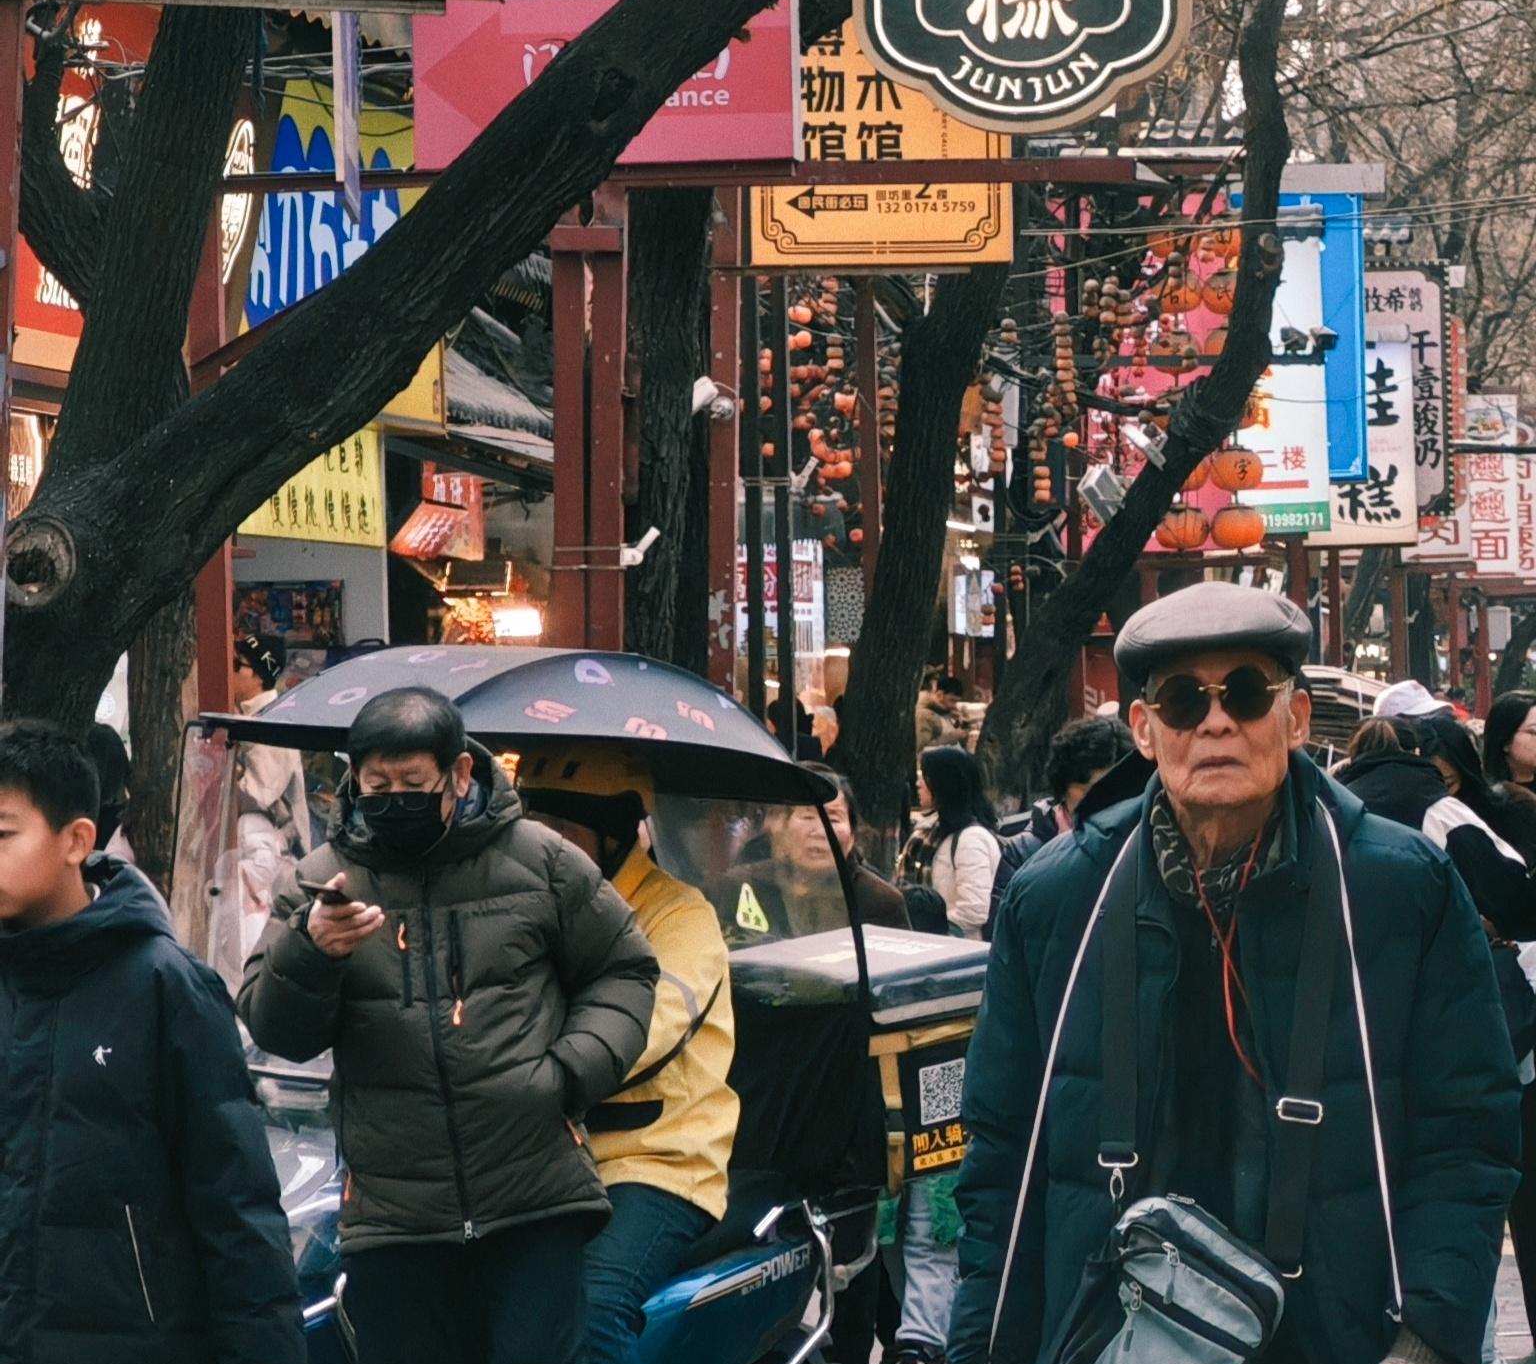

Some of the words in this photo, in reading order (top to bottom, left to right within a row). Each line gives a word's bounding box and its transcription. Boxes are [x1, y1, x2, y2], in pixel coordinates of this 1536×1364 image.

[951, 52, 1100, 103] JUNJUN
[876, 201, 900, 214] 132
[904, 200, 938, 214] 0174
[942, 200, 976, 213] 5759
[912, 1122, 968, 1153] 加入骑
[760, 1241, 812, 1287] POWER
